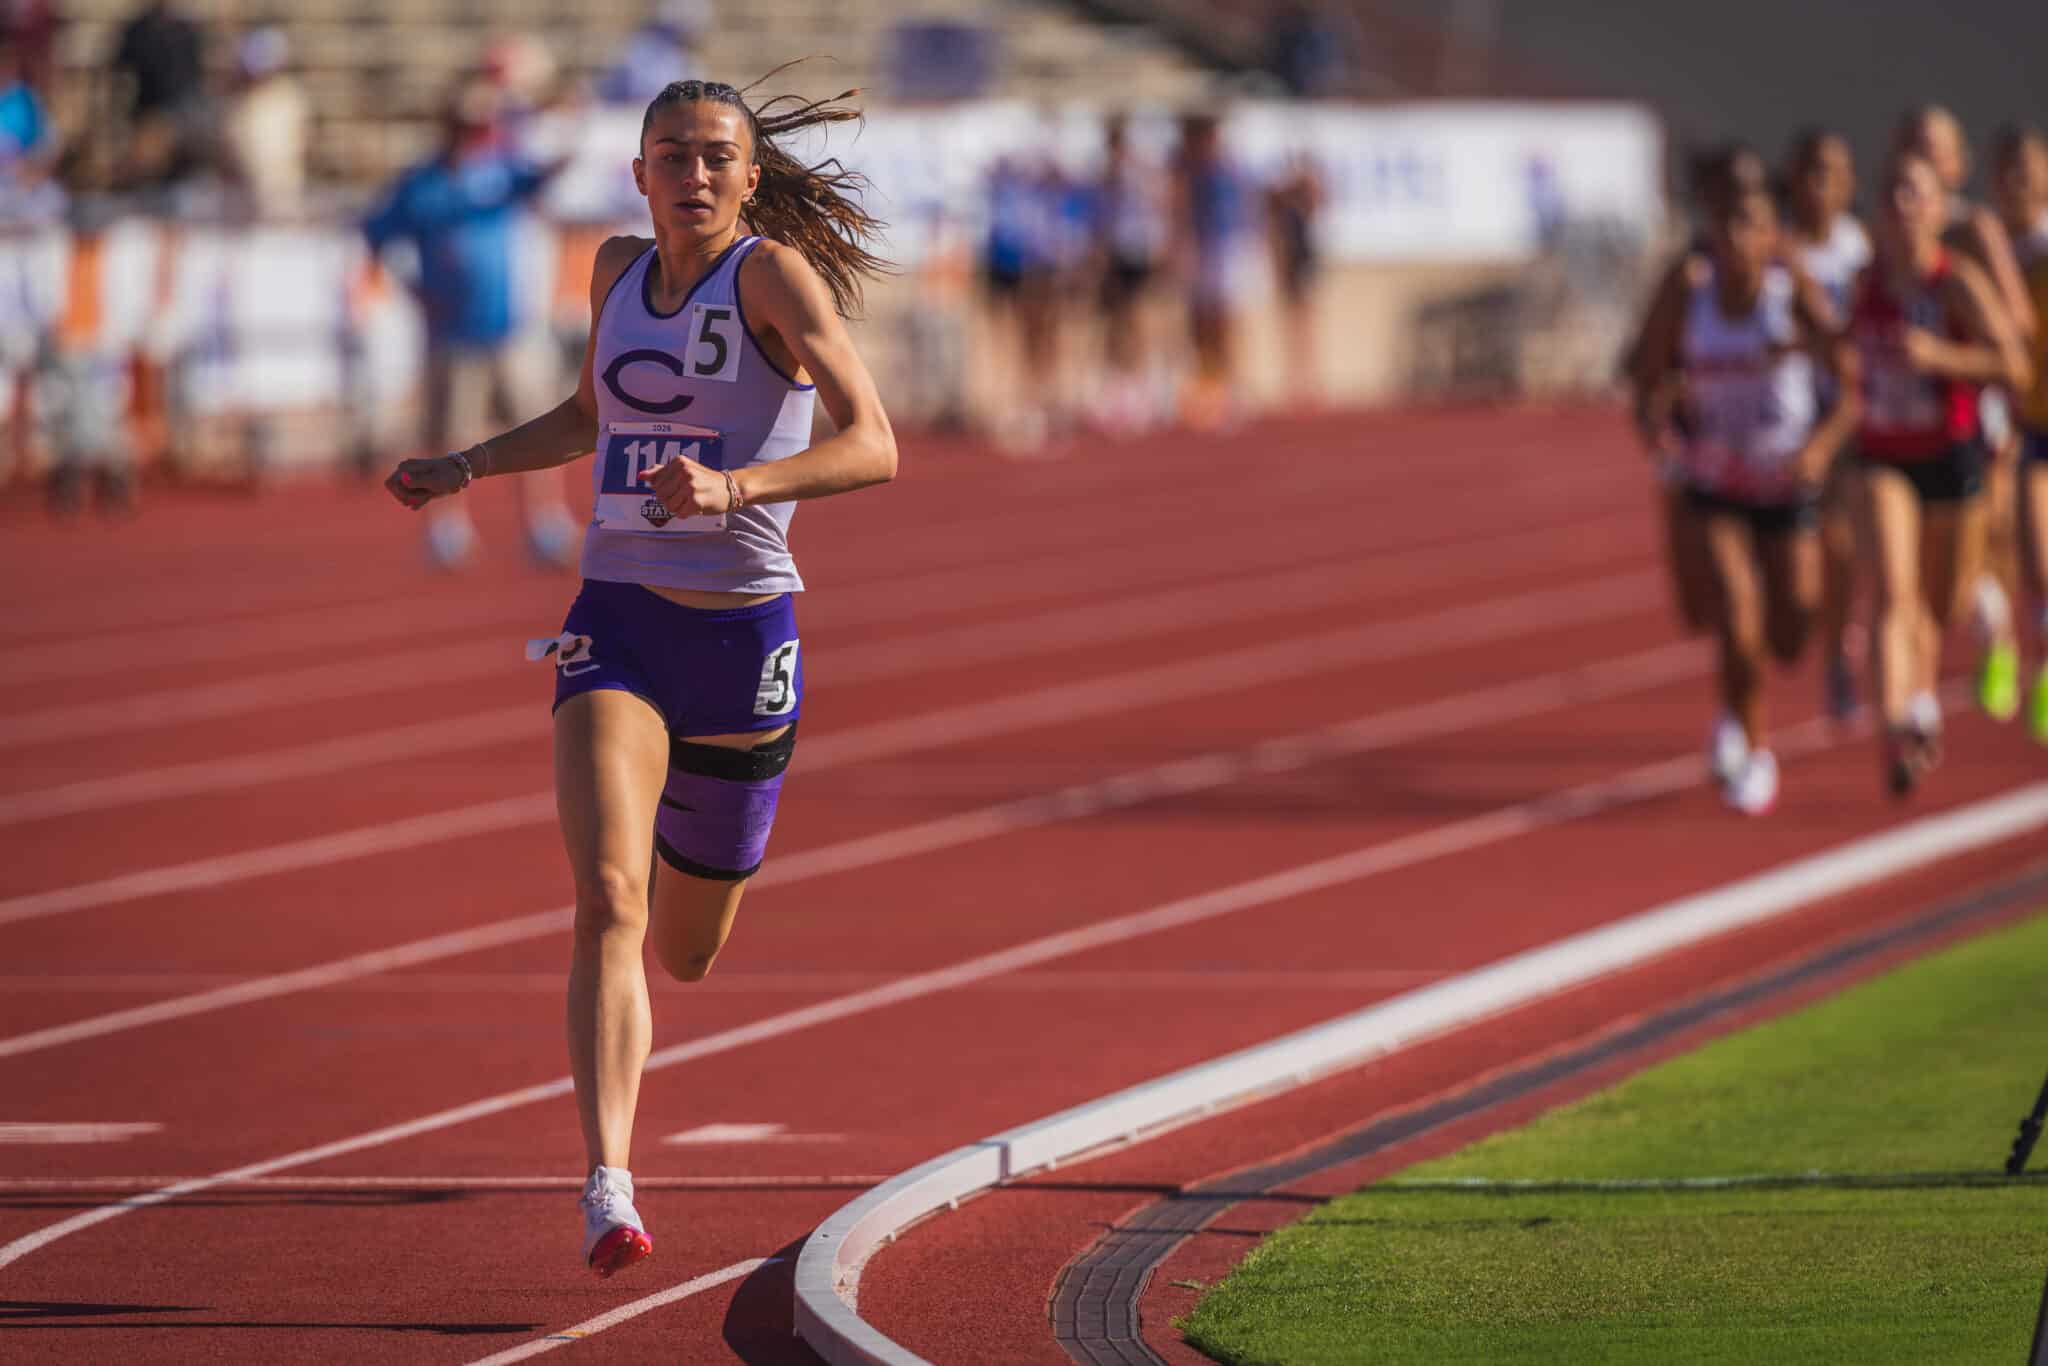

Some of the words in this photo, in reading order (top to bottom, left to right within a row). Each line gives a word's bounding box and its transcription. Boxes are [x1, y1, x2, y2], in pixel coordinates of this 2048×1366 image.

[694, 309, 731, 376] 5
[601, 348, 695, 415] C
[766, 646, 793, 712] 5
